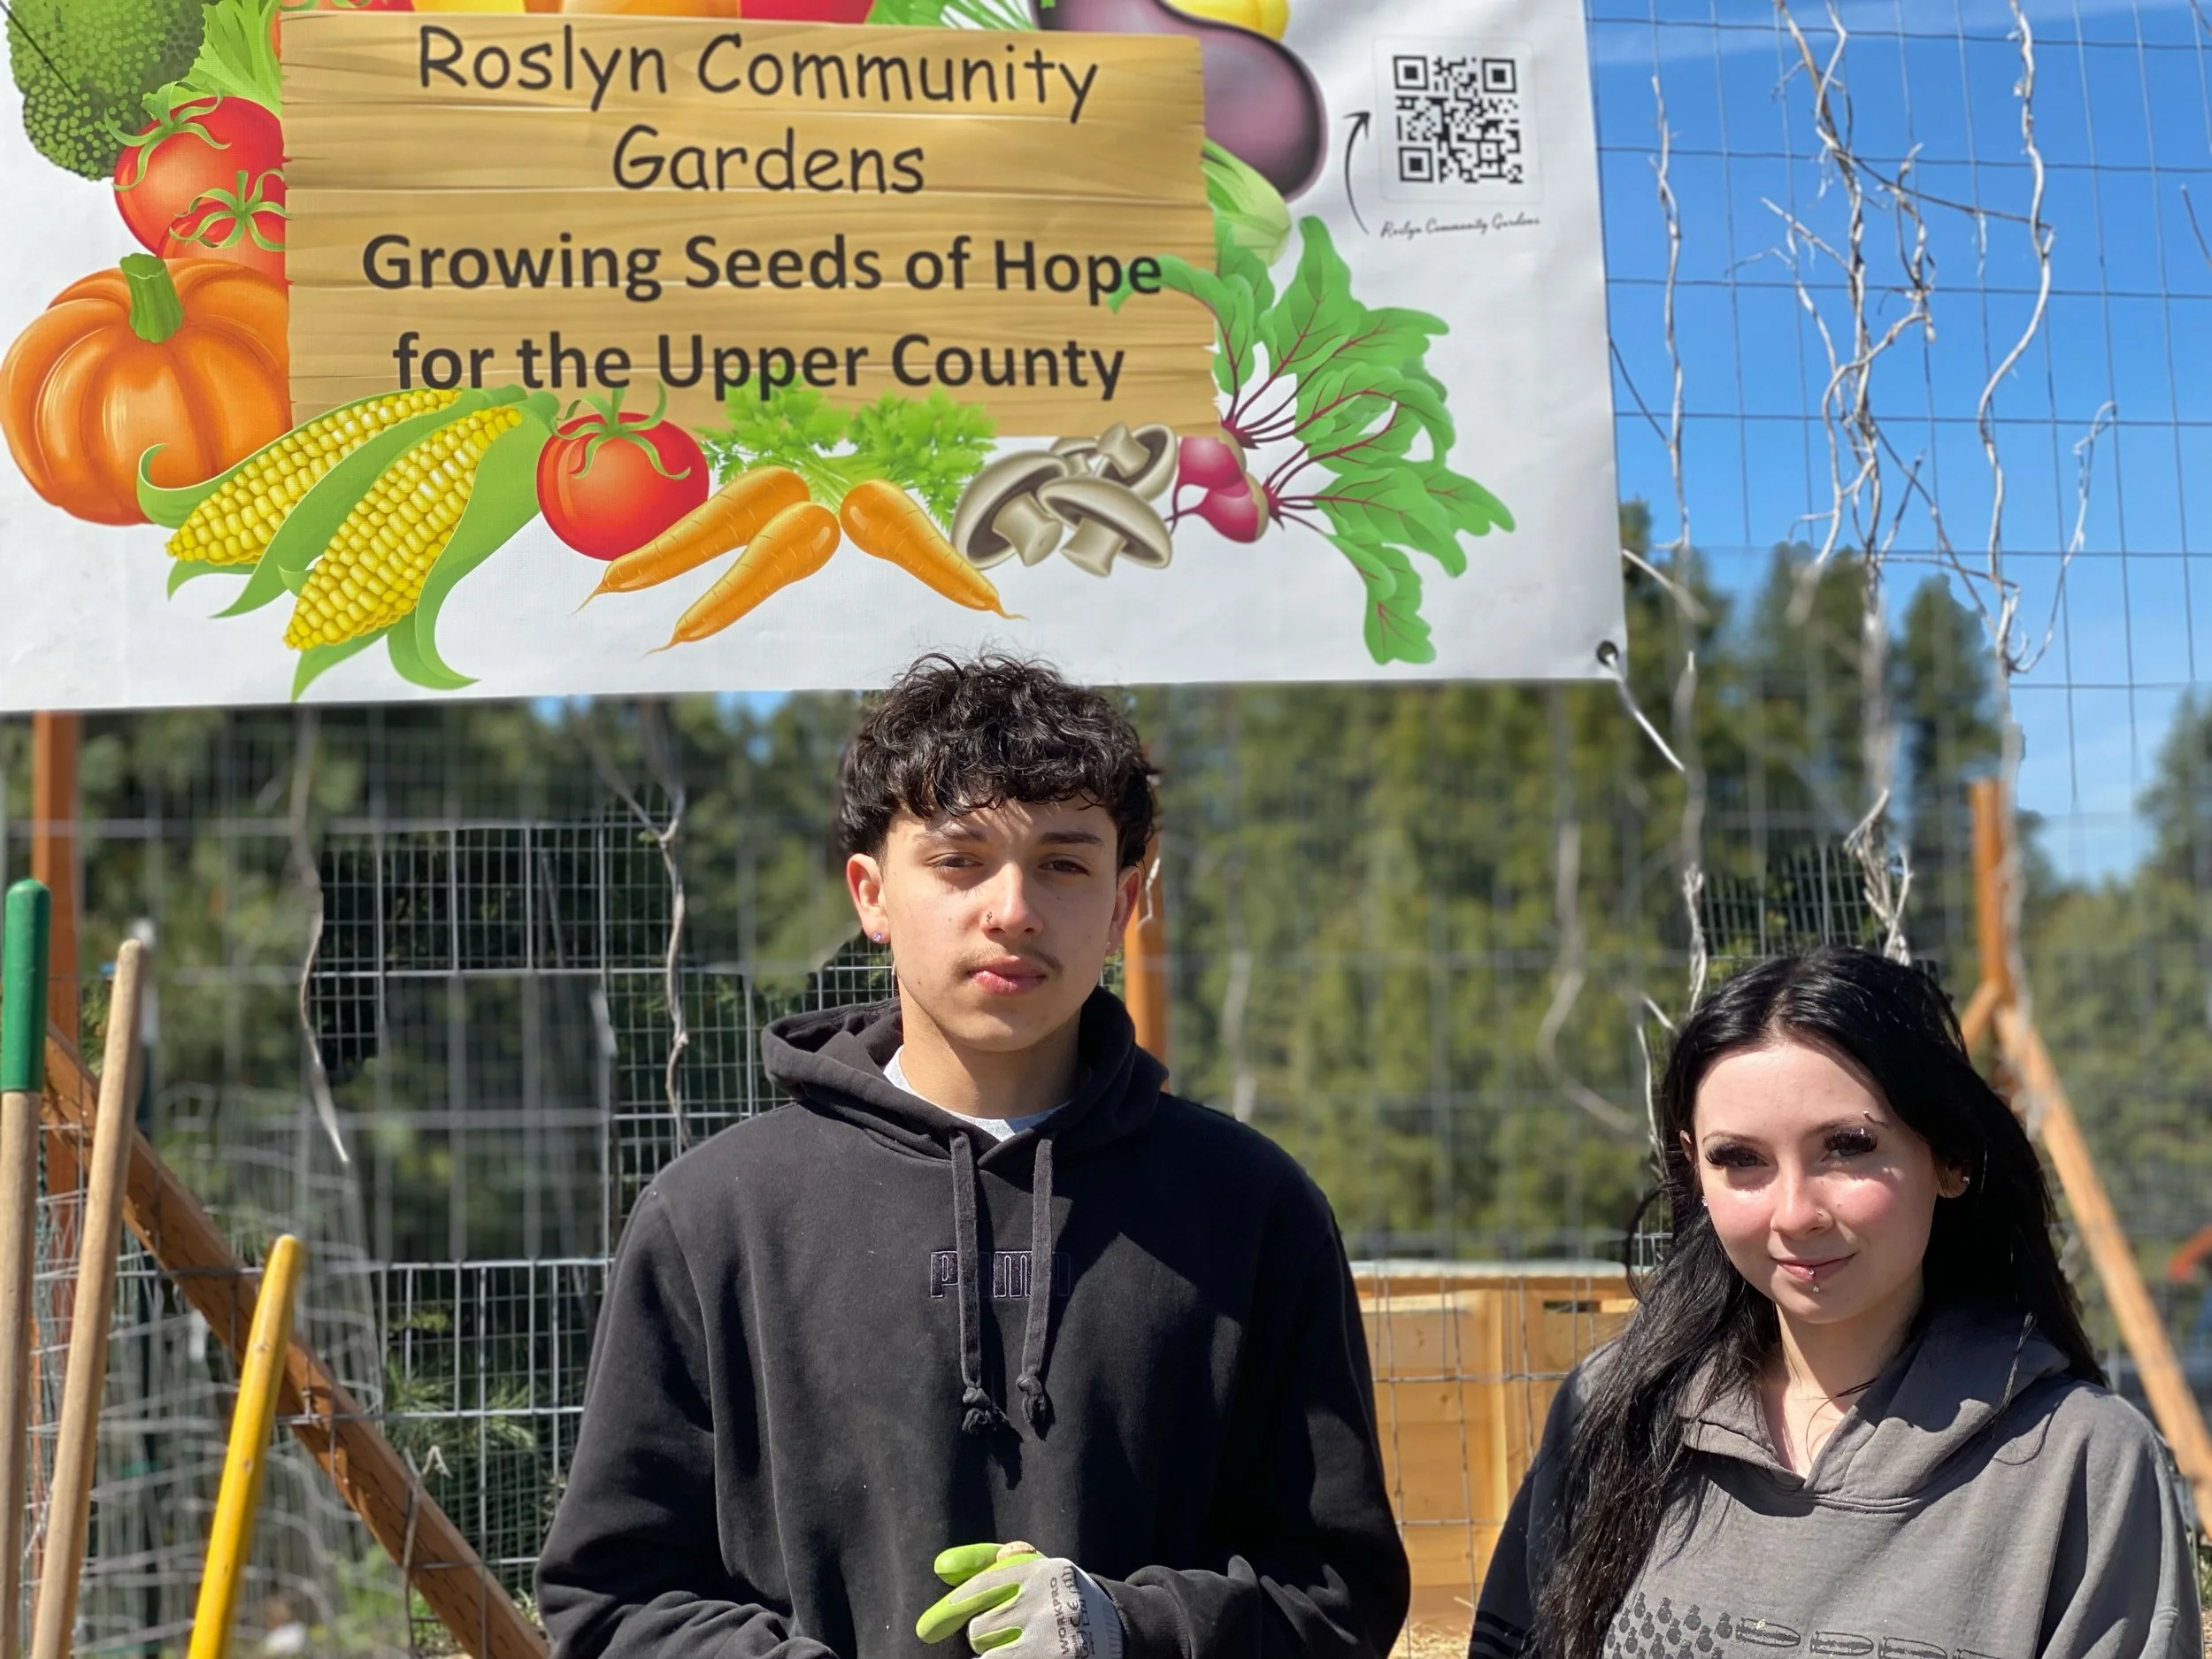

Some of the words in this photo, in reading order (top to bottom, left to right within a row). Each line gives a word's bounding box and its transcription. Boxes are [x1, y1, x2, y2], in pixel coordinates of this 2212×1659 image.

[420, 25, 666, 111] Roslyn
[698, 33, 1097, 124] Community
[613, 124, 924, 194] Gardens
[363, 233, 662, 303] Growing
[686, 234, 881, 289] Seeds
[906, 235, 971, 290] of
[995, 240, 1162, 306] Hope
[392, 331, 495, 390] for
[516, 331, 631, 389] the
[658, 334, 869, 402] Upper
[892, 334, 1125, 401] County
[1050, 1577, 1069, 1655] WORKPRO
